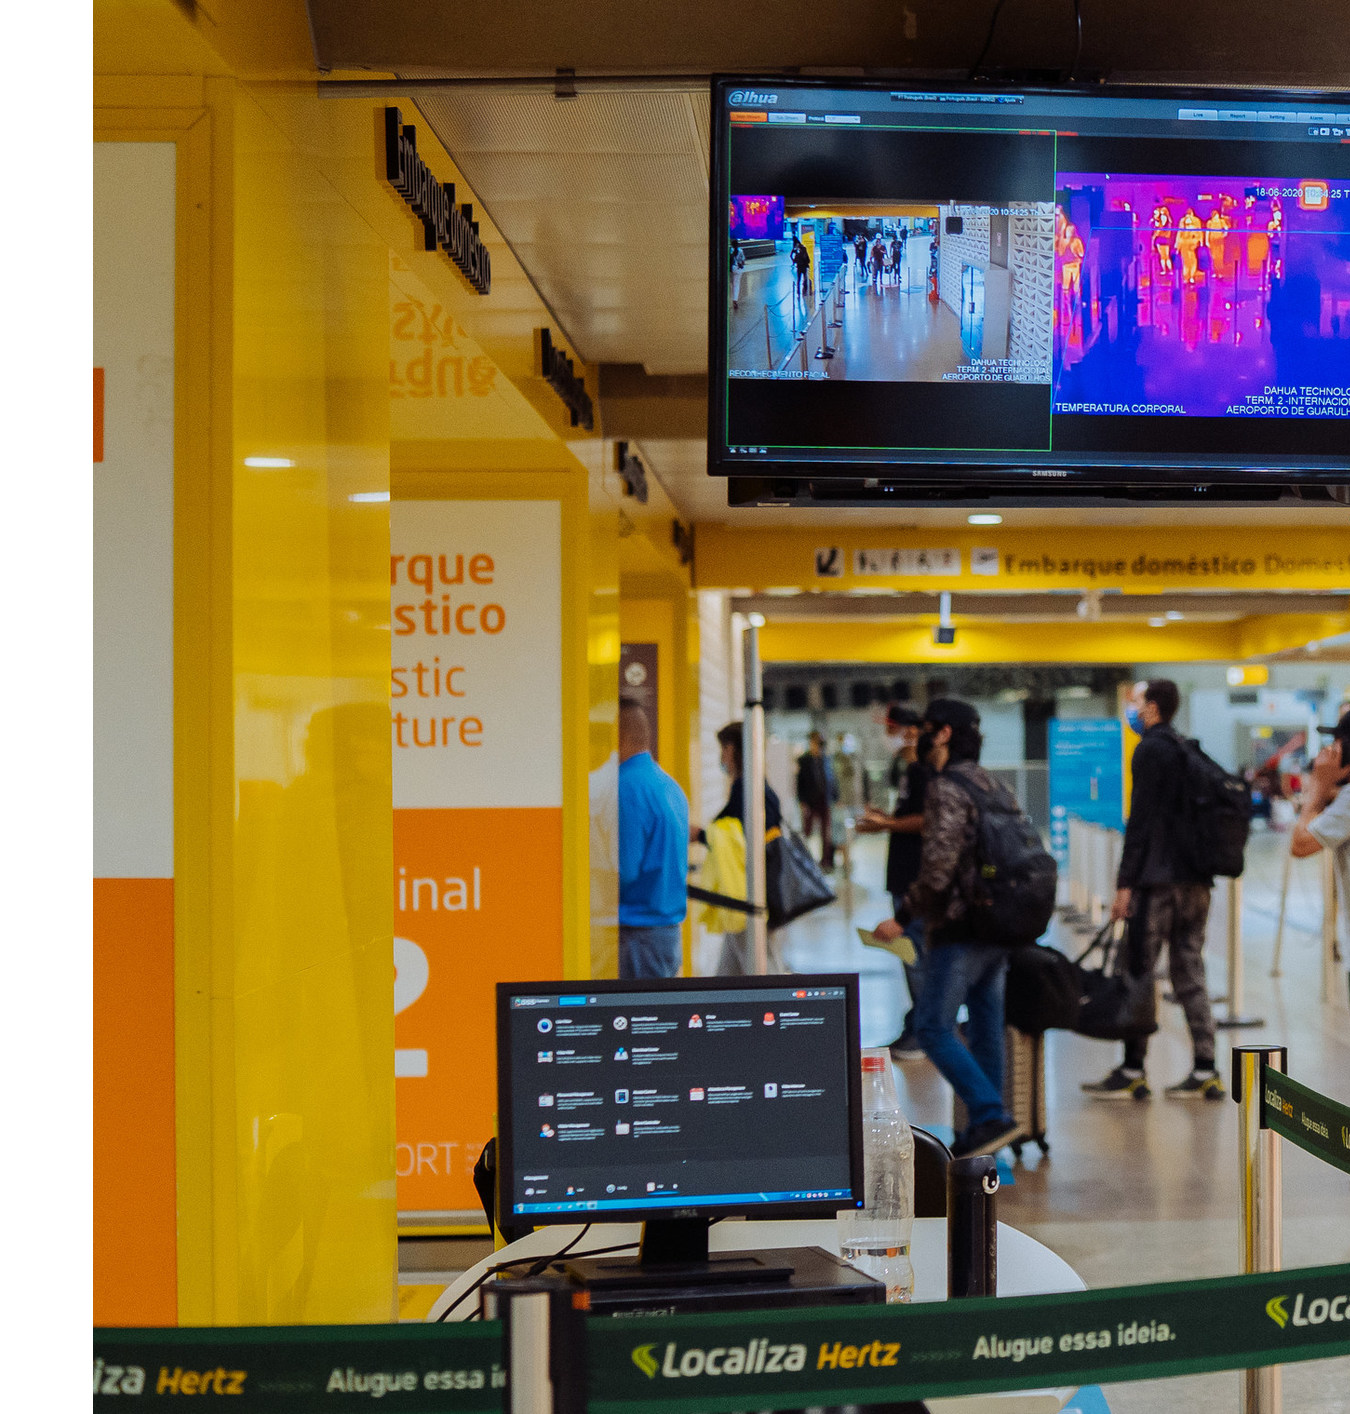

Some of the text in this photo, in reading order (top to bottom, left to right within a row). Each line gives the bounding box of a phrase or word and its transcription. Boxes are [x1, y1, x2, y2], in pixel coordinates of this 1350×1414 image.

[1256, 188, 1303, 197] 18-06-2020
[998, 359, 1051, 367] TECHNOLOGY
[729, 369, 831, 379] RECONHECIMENTO FACIAL
[942, 373, 991, 381] AEROPORTO
[1264, 386, 1297, 395] DAHUA
[1245, 396, 1275, 404] TERM.
[1278, 396, 1284, 405] 2
[1056, 403, 1187, 414] TEMPERATURA CORPORAL
[1226, 405, 1289, 415] AEROPORTO
[1291, 406, 1305, 415] DE
[1003, 553, 1127, 578] Embarque
[1131, 553, 1257, 576] doméstico
[973, 1320, 1177, 1362] Alugue essa ideia.
[662, 1338, 901, 1378] Localiza Hertz
[156, 1365, 248, 1396] Hertz
[326, 1366, 418, 1398] Alugue
[423, 1371, 484, 1391] essa
